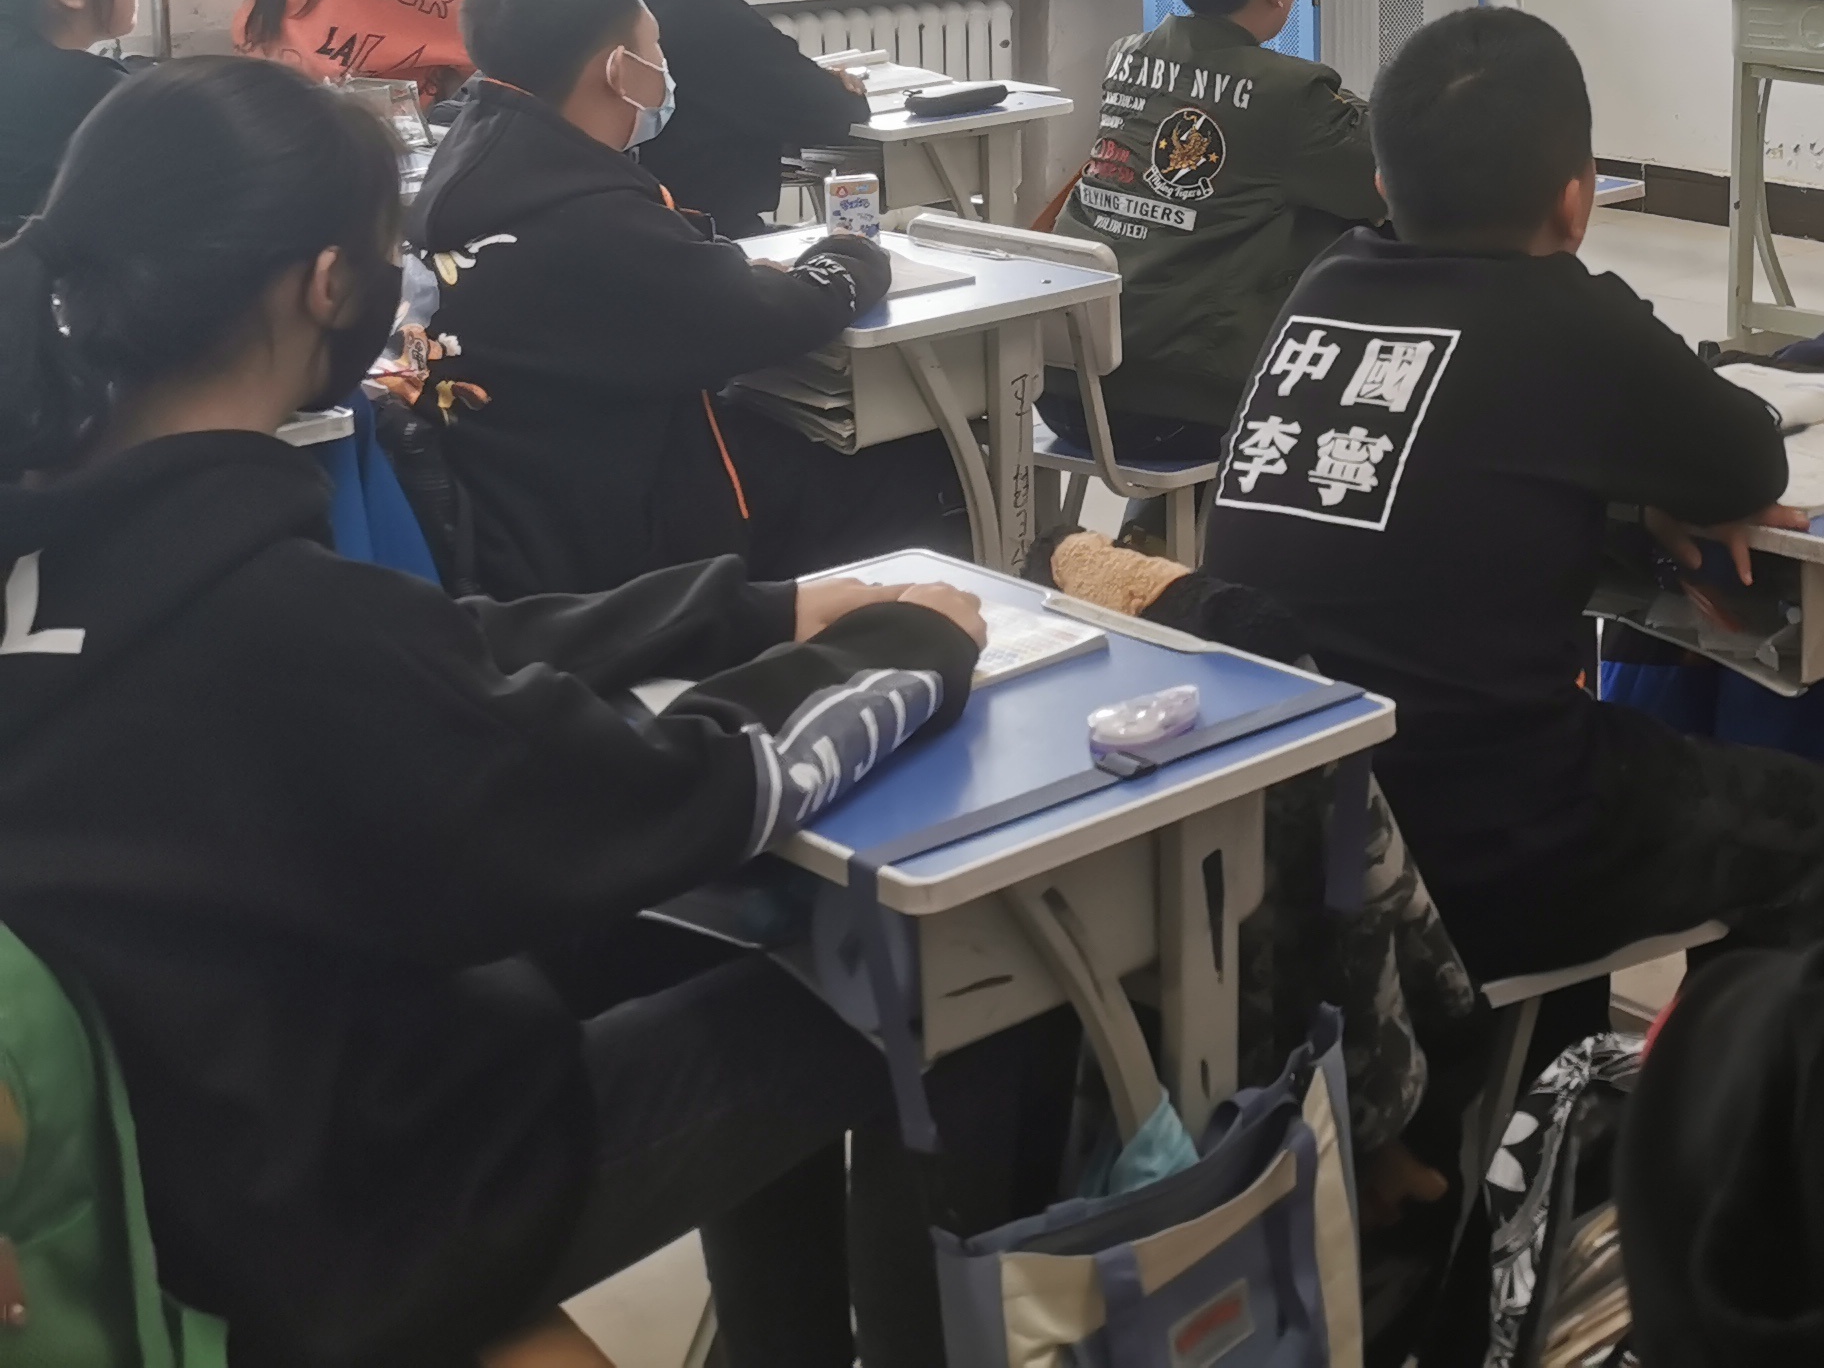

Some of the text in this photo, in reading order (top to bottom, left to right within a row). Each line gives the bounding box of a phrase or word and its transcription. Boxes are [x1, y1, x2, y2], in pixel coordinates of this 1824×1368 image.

[1191, 68, 1253, 109] NVG
[1083, 189, 1185, 225] FLYING TIGERS
[1270, 329, 1436, 413] 中國
[1233, 415, 1394, 507] 李寧
